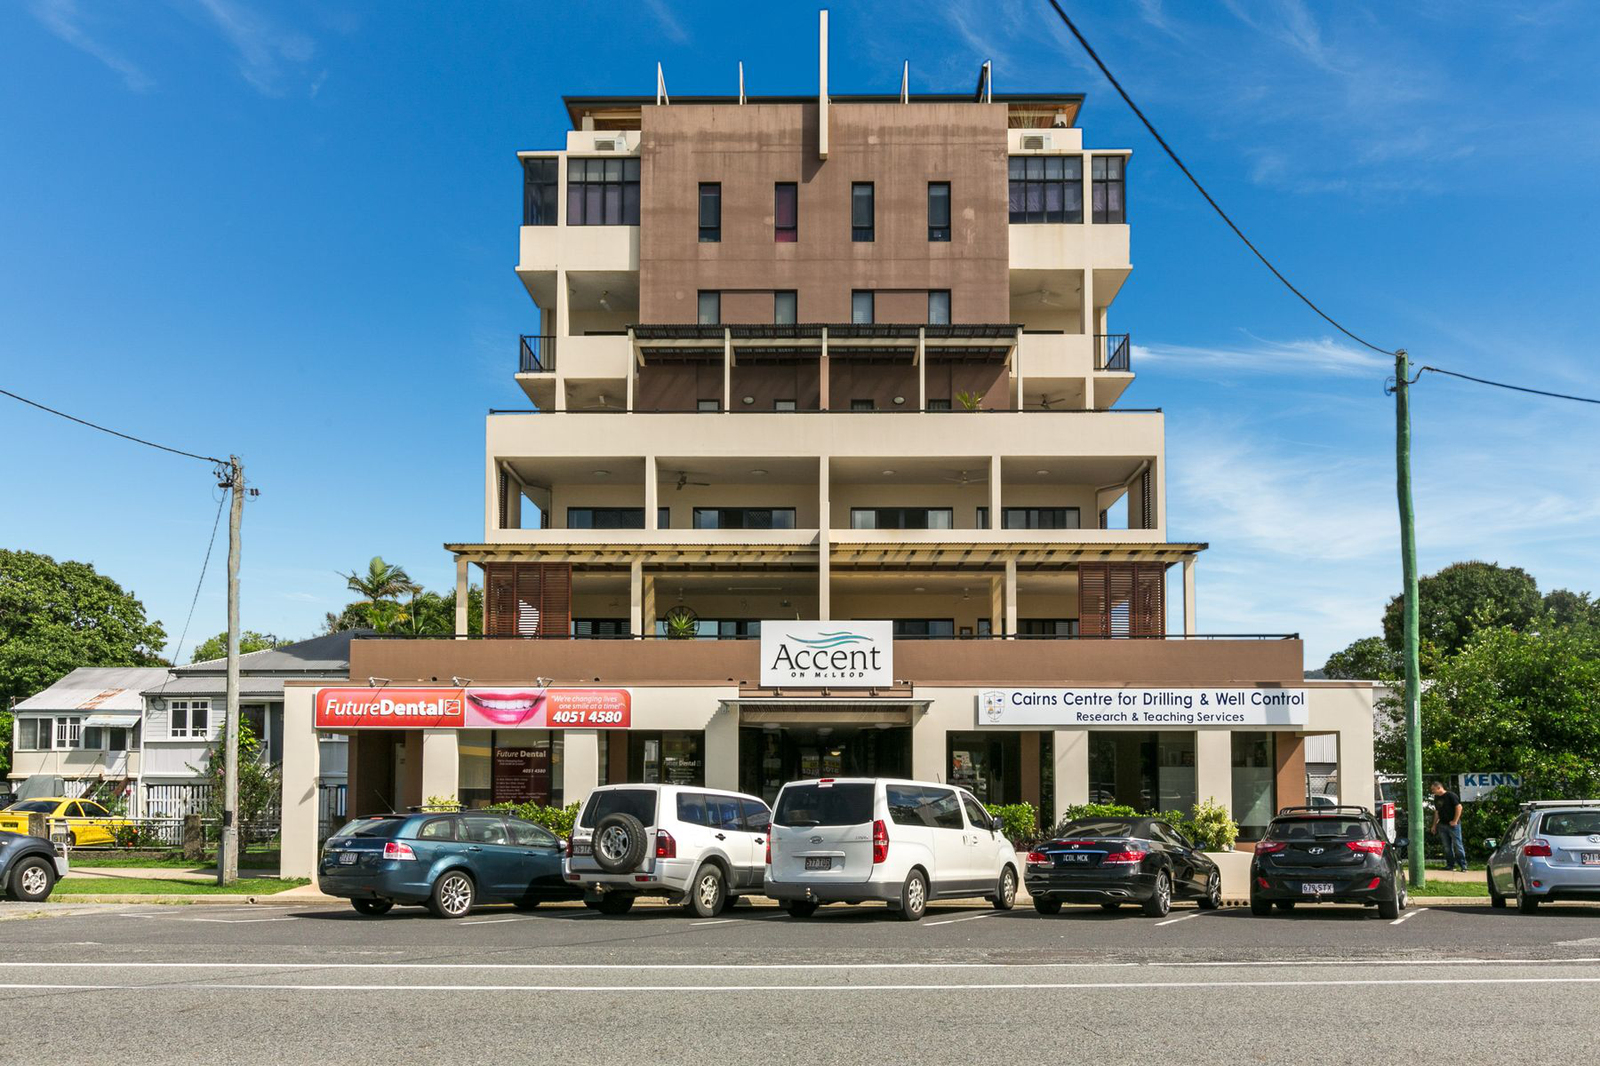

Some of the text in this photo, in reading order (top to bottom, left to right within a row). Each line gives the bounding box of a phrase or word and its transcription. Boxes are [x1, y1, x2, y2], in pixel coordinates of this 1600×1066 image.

[771, 643, 881, 671] Accent
[572, 695, 602, 703] changing
[1011, 692, 1304, 709] Cairns Centre for Drilling & Well Control
[553, 711, 622, 723] 4051 4580
[1076, 711, 1245, 724] Research & Teaching Services
[496, 750, 546, 758] Future Dental
